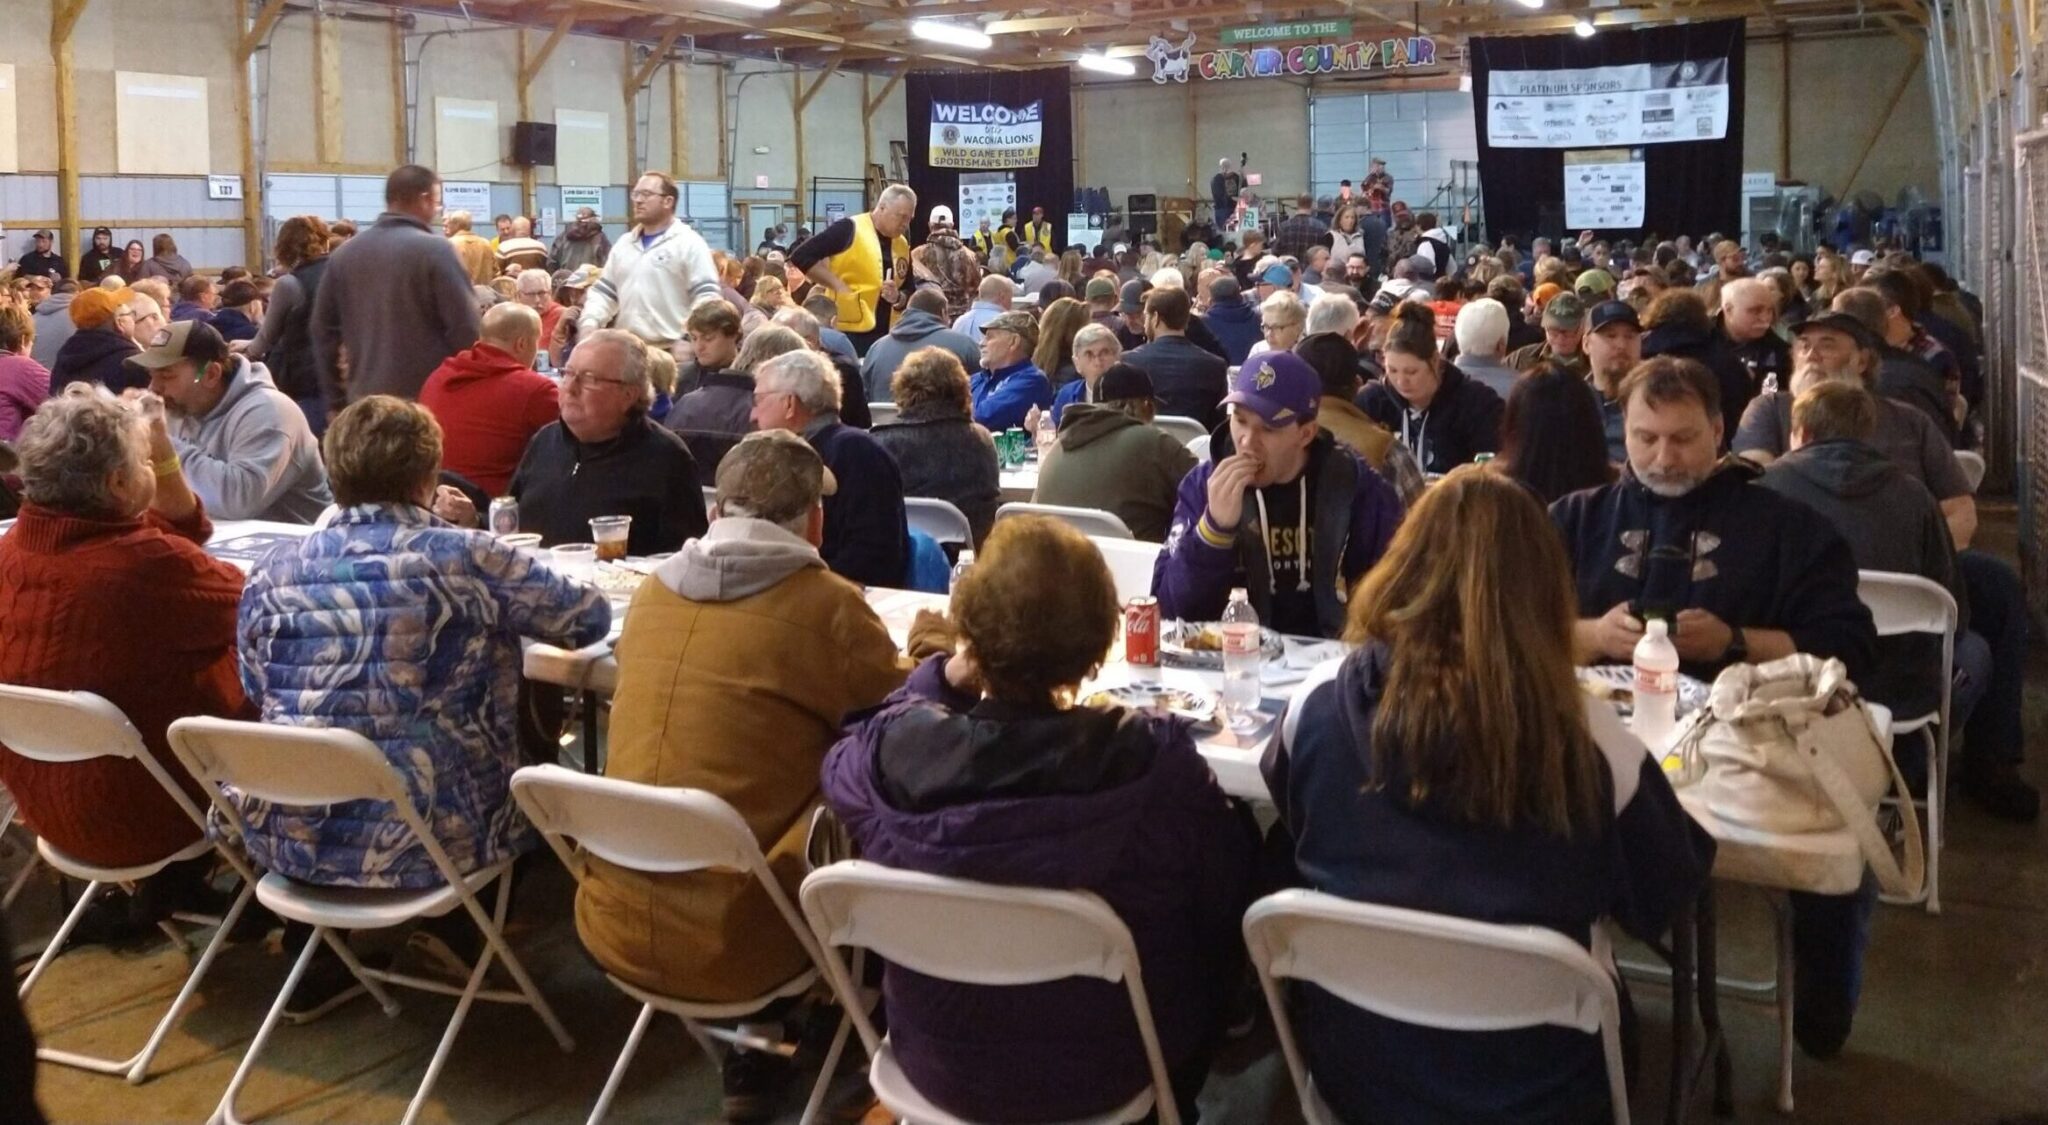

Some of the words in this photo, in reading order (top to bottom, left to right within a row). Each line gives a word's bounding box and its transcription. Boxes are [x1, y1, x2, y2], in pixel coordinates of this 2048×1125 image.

[1234, 27, 1292, 39] WELCOME
[1294, 25, 1310, 36] TO
[1313, 22, 1337, 34] THE
[1199, 48, 1283, 79] CARVER
[1287, 41, 1377, 75] COUNTY
[1382, 36, 1436, 68] FAIR
[1520, 81, 1568, 94] PLATINUM
[1570, 79, 1622, 93] SPONSORS
[936, 103, 1039, 124] WELCOME
[1005, 134, 1034, 145] LIONS
[942, 148, 967, 157] WILD
[970, 149, 995, 158] GAME
[998, 149, 1024, 157] FEED
[934, 157, 1001, 167] SPORTSMAN'S
